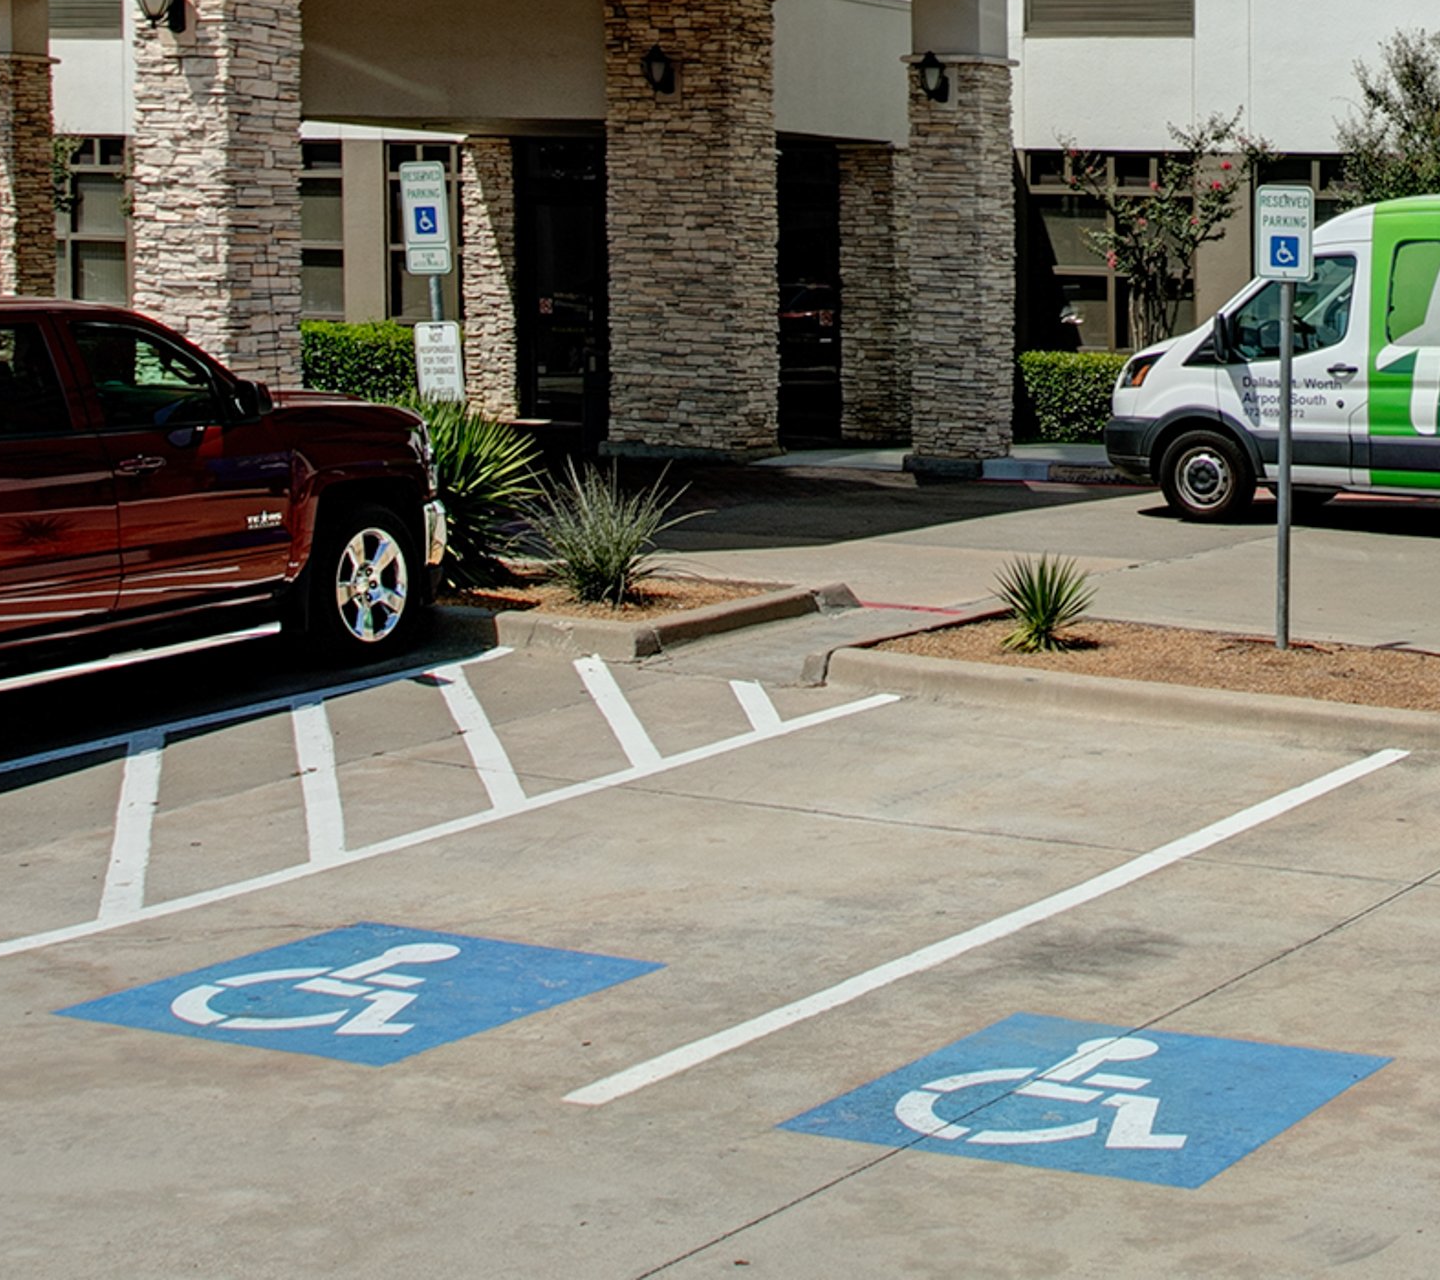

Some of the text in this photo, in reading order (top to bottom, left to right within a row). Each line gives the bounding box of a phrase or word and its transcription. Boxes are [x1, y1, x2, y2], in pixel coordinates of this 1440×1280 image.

[407, 188, 440, 199] PARKING
[1260, 195, 1310, 209] RESERVED
[1263, 215, 1308, 228] PARKING
[1303, 377, 1342, 390] Worth
[1242, 392, 1280, 407] Airpor
